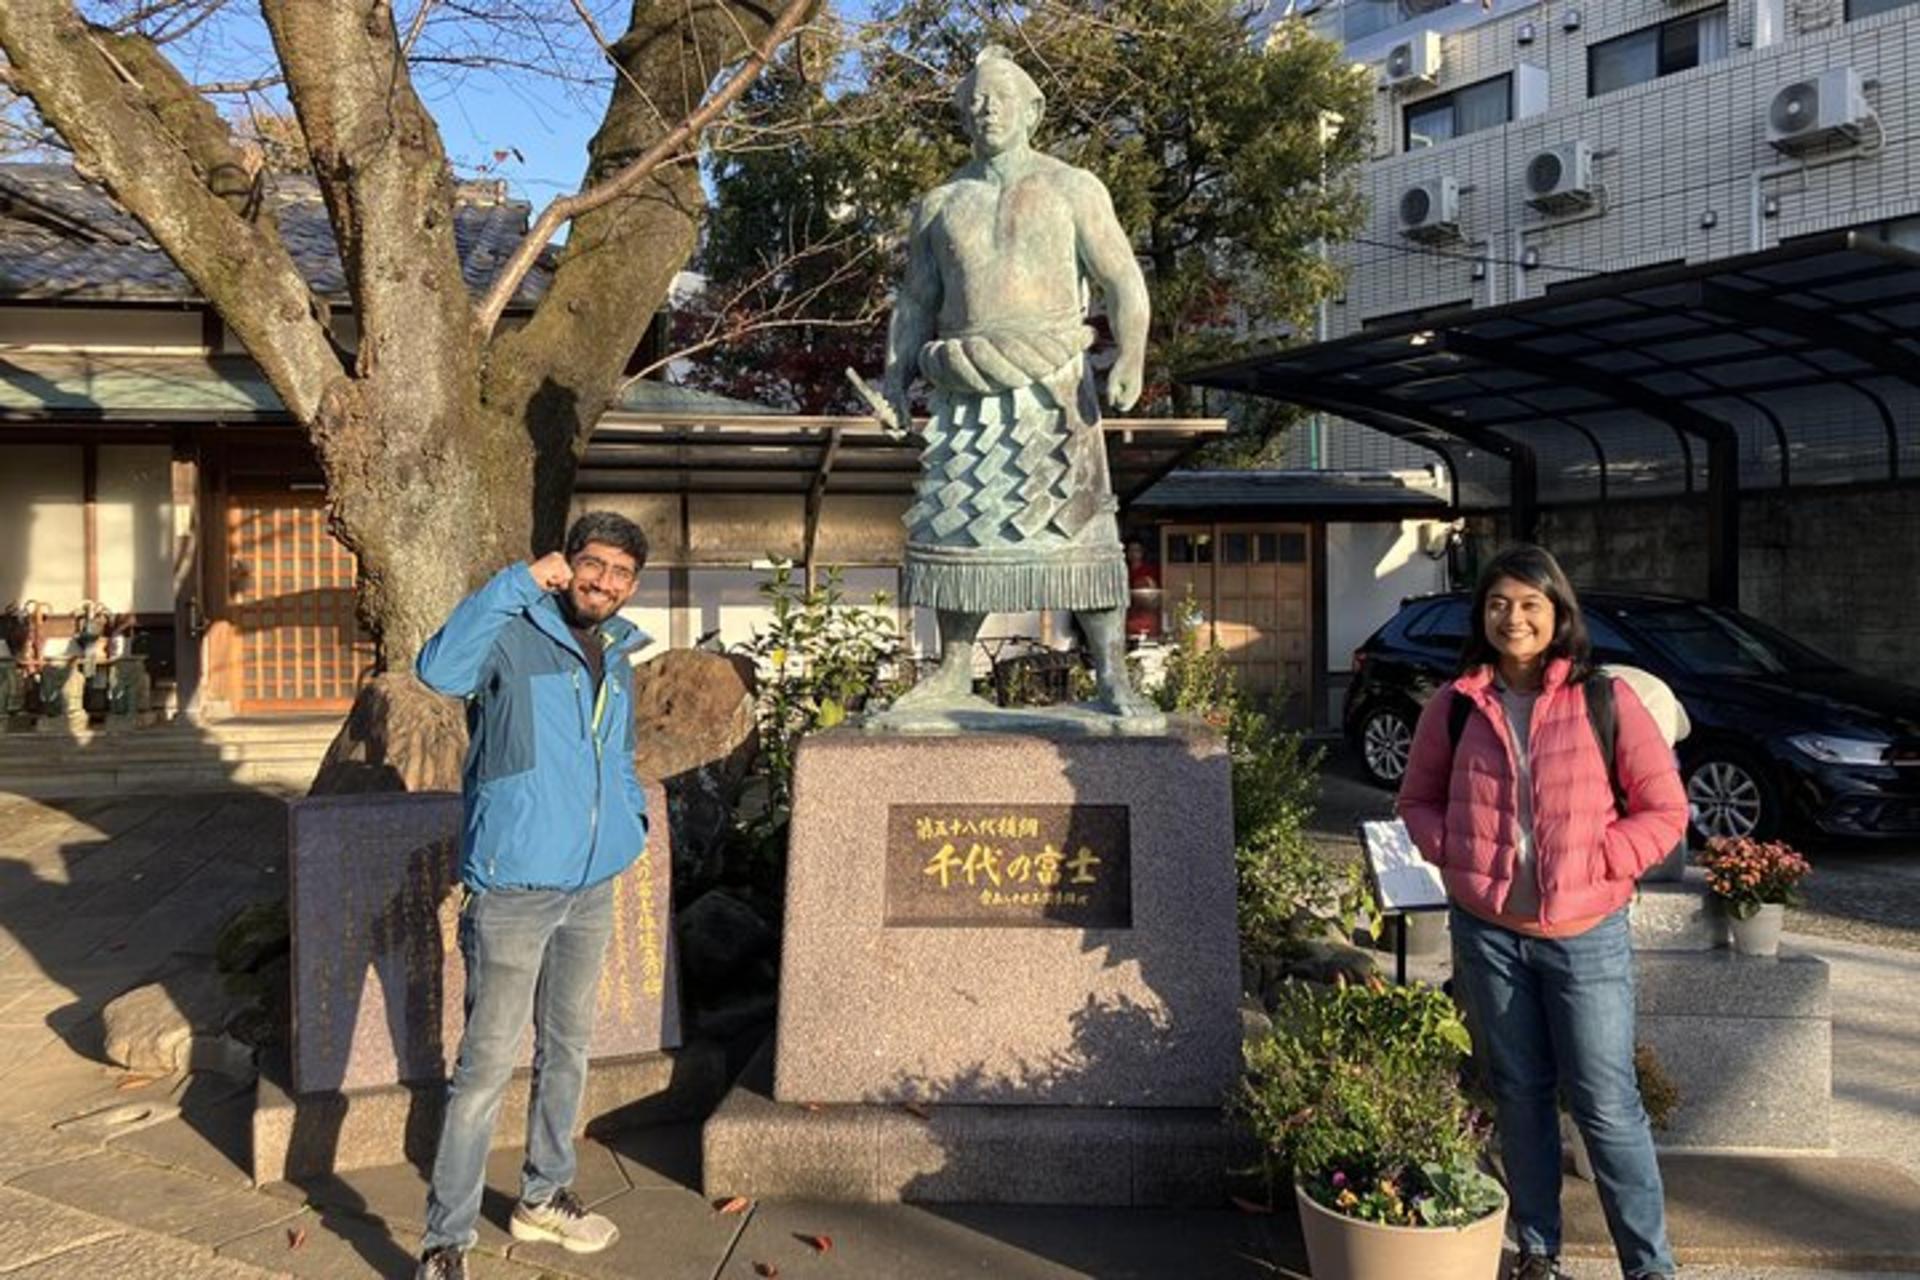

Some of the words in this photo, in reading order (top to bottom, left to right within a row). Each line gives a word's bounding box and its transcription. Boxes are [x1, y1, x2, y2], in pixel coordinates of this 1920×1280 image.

[923, 843, 1101, 888] 千代の富士
